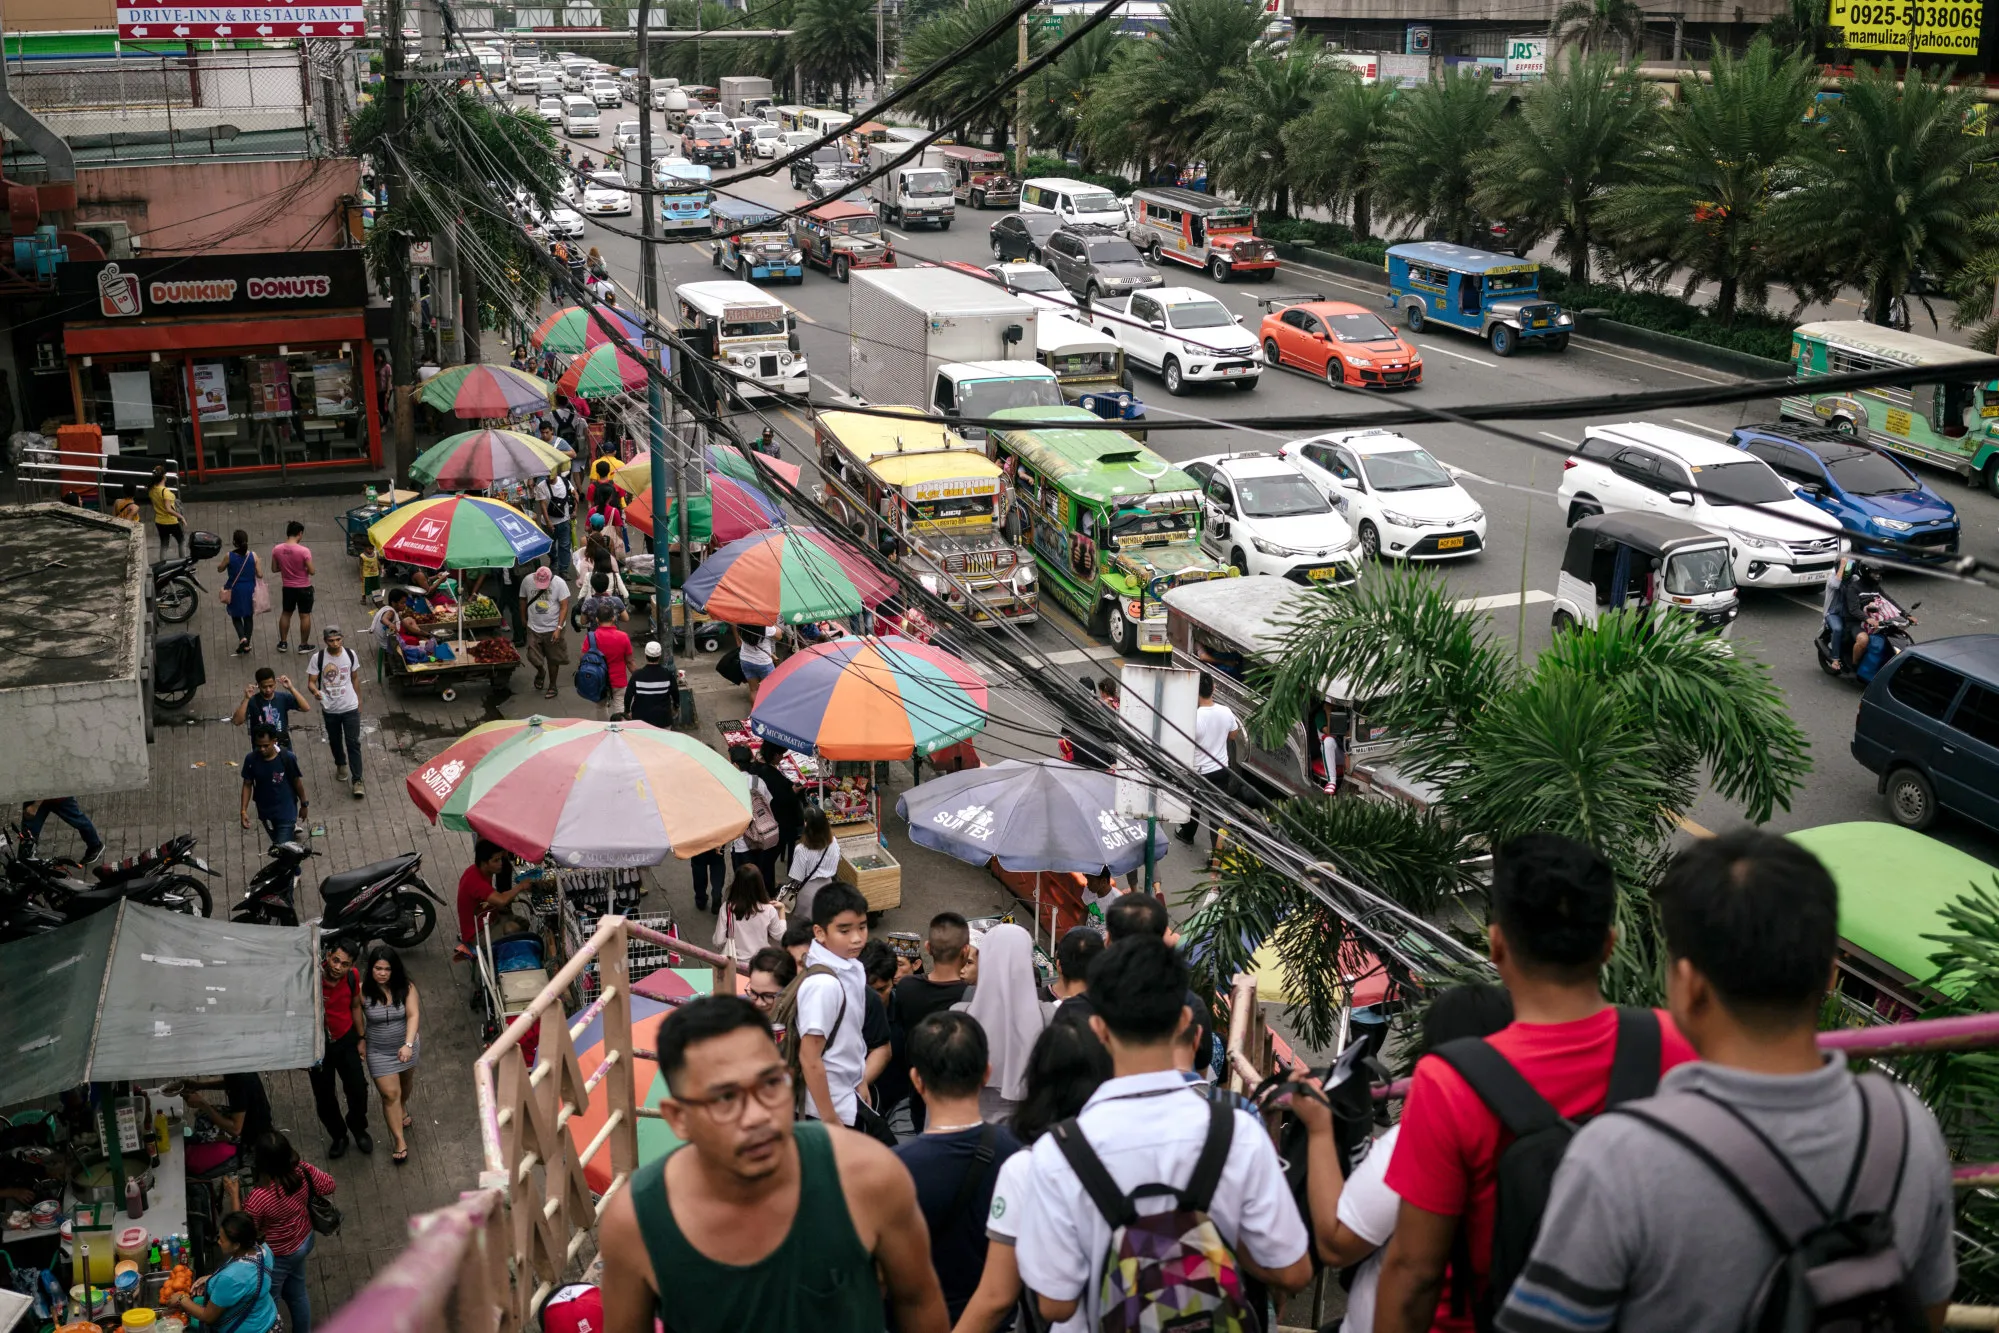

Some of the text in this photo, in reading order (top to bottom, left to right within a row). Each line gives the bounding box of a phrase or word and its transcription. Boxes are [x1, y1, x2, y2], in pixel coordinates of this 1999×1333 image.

[129, 8, 352, 22] DRIVE-INN & RESTAURANT
[1850, 4, 1983, 29] 0925-5038069
[1849, 29, 1980, 50] mamuliza@yahoo.com
[1509, 42, 1533, 60] JRS
[1515, 63, 1543, 71] EXPRESS
[152, 279, 328, 301] DUNKIN' DONUTS
[765, 727, 806, 749] MICROMATIC
[421, 767, 455, 799] SUNTEX
[933, 811, 995, 842] SUNTEX
[1101, 822, 1148, 850] SUNTEX
[586, 852, 654, 863] MICROMATIC
